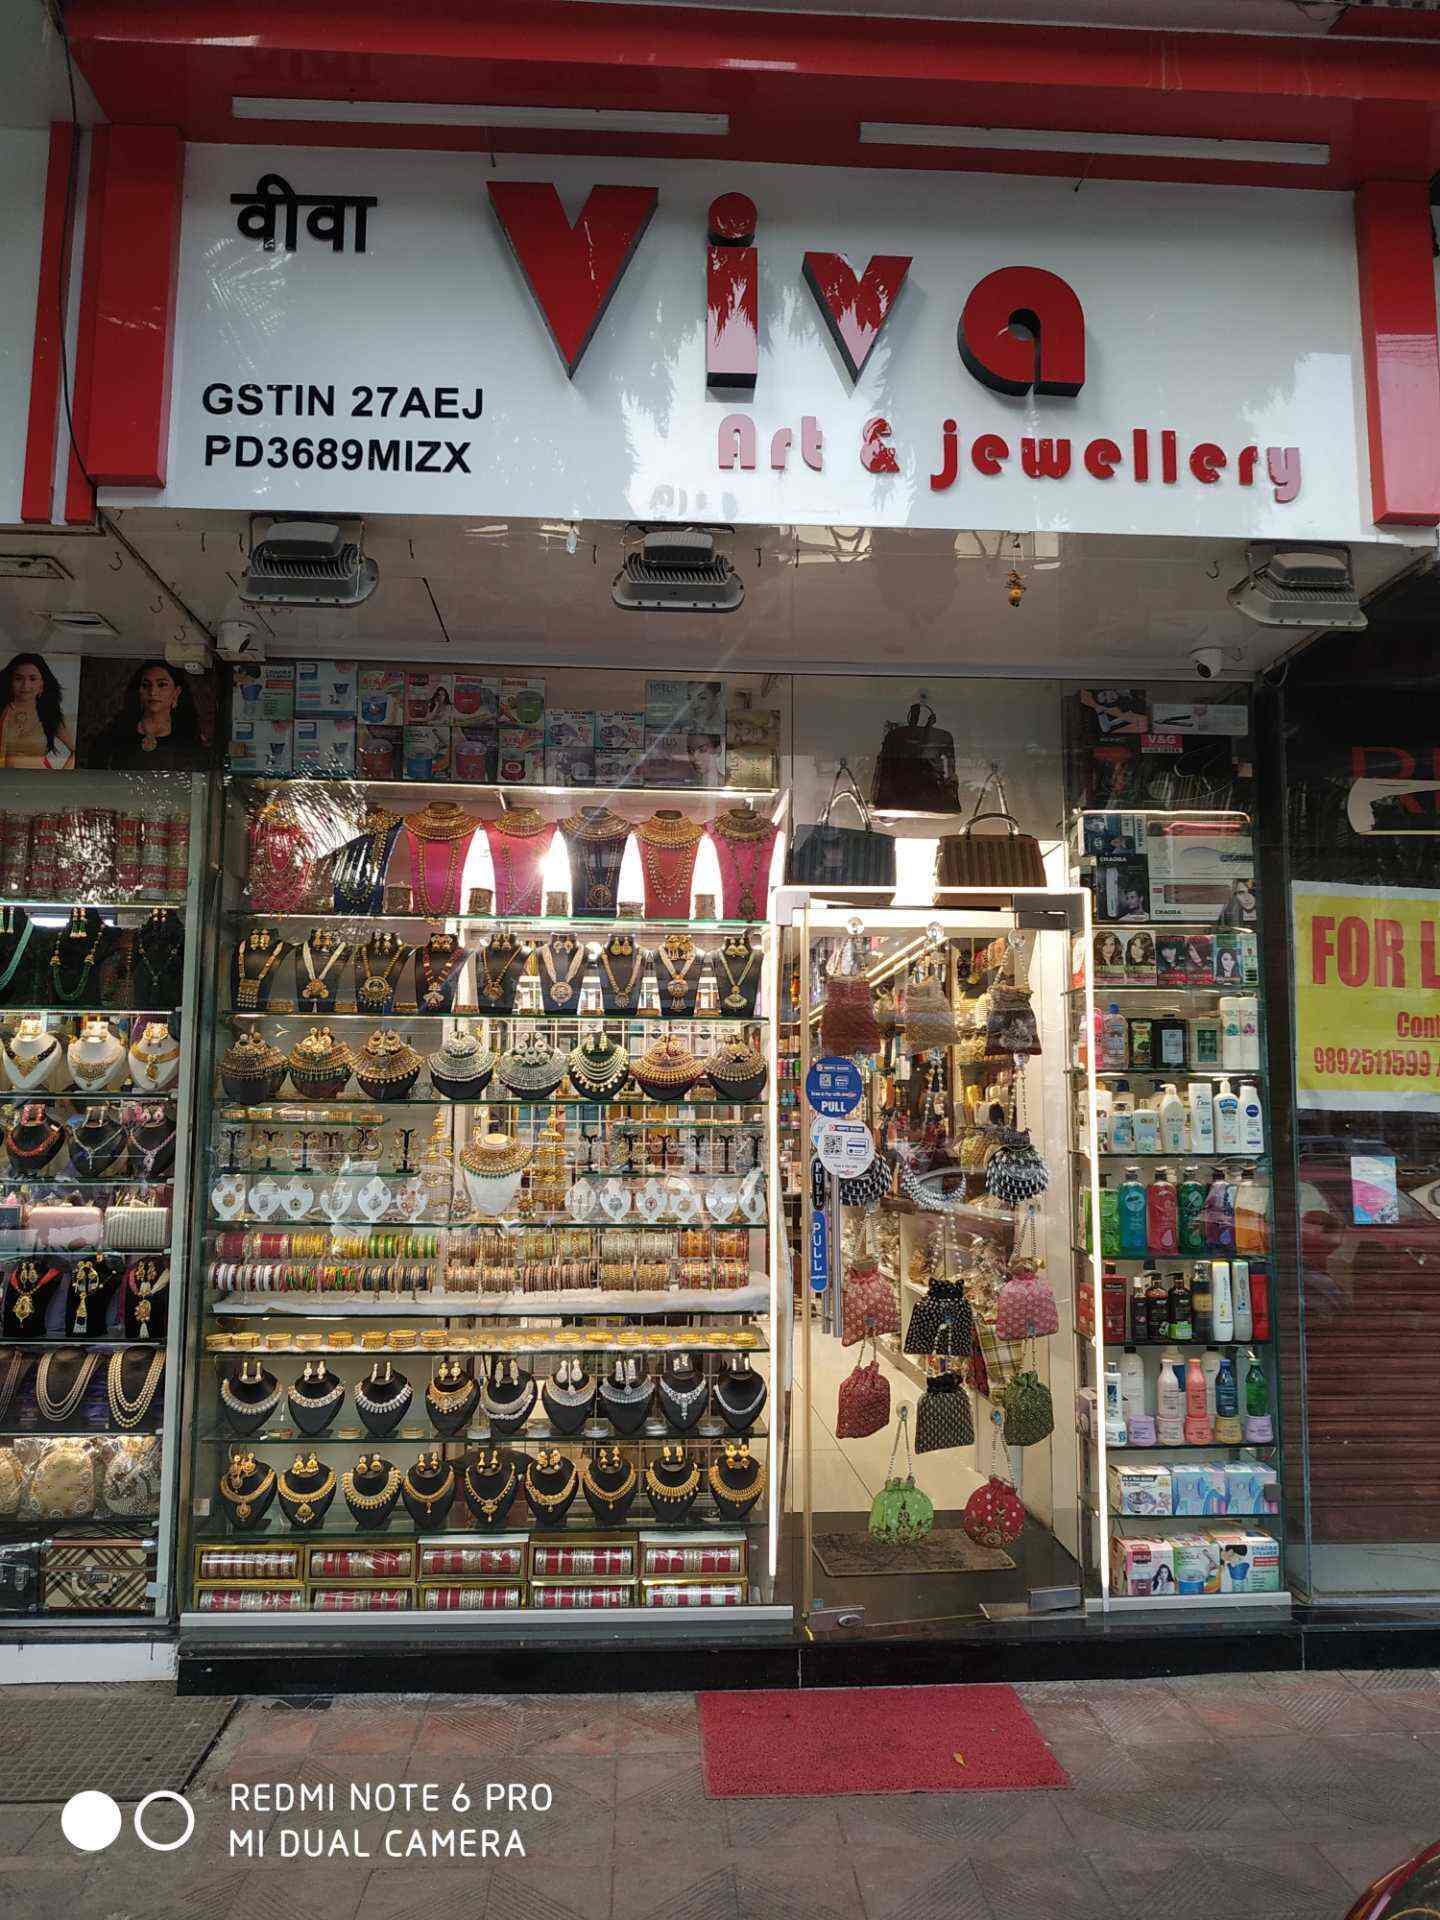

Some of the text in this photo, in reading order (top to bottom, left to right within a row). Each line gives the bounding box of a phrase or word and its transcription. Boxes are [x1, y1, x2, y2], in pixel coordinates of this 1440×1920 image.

[230, 173, 378, 252] वीवा
[486, 180, 1086, 398] Viva
[202, 383, 484, 420] GSTIN 27AEJ
[204, 434, 472, 474] PD3689MIZX
[718, 413, 1302, 504] Art & jewellery
[1312, 915, 1406, 989] FOR
[1313, 1046, 1431, 1077] 9892511599
[821, 1100, 847, 1113] PULL
[812, 1222, 823, 1271] PULL
